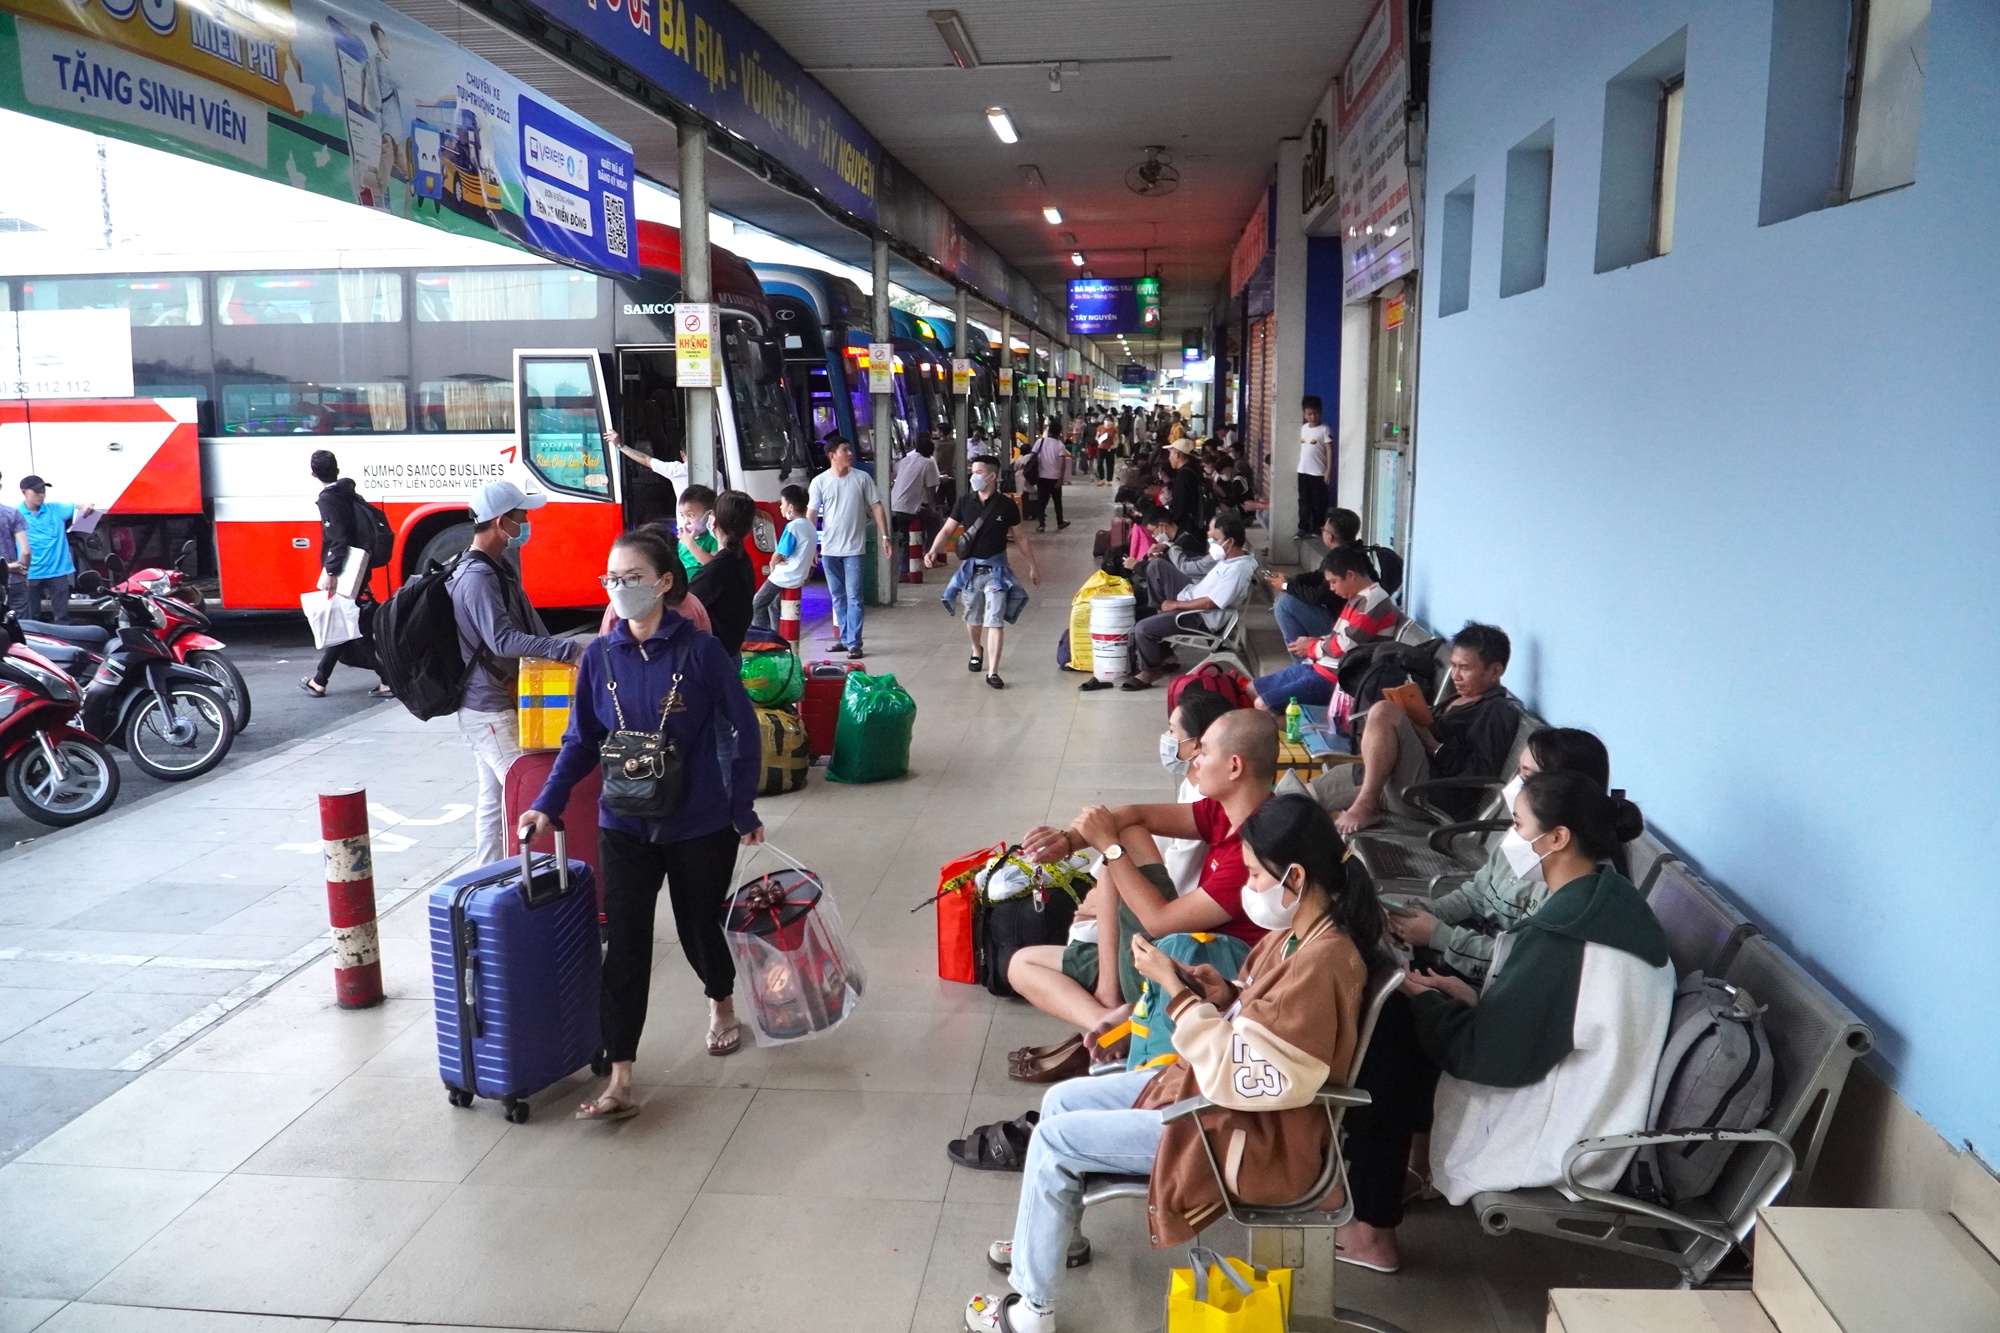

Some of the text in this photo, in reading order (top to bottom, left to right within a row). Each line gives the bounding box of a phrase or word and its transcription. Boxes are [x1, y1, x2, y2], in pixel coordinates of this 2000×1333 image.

[246, 37, 280, 85] PHÍ
[52, 49, 247, 145] TẶNG SINH VIÊN
[466, 72, 501, 101] CHUYẾN XE
[496, 106, 511, 123] 2022
[695, 14, 727, 94] RỊA
[740, 49, 783, 131] VŨNG
[785, 84, 811, 151] TÀU
[818, 113, 839, 170] TÂY
[837, 148, 875, 199] NGUYÊN
[554, 204, 569, 223] MIỀN
[570, 212, 587, 229] ĐÔNG
[623, 303, 674, 315] SAMCO
[13, 381, 30, 394] 35
[36, 381, 60, 393] 112
[66, 380, 91, 392] 112
[363, 463, 505, 477] KUMHO SAMCO BUSLINES
[364, 478, 390, 489] CÔNG
[392, 479, 403, 488] TY
[406, 478, 426, 489] LIÊN
[429, 479, 461, 488] DOANH
[463, 477, 484, 491] VIỆT
